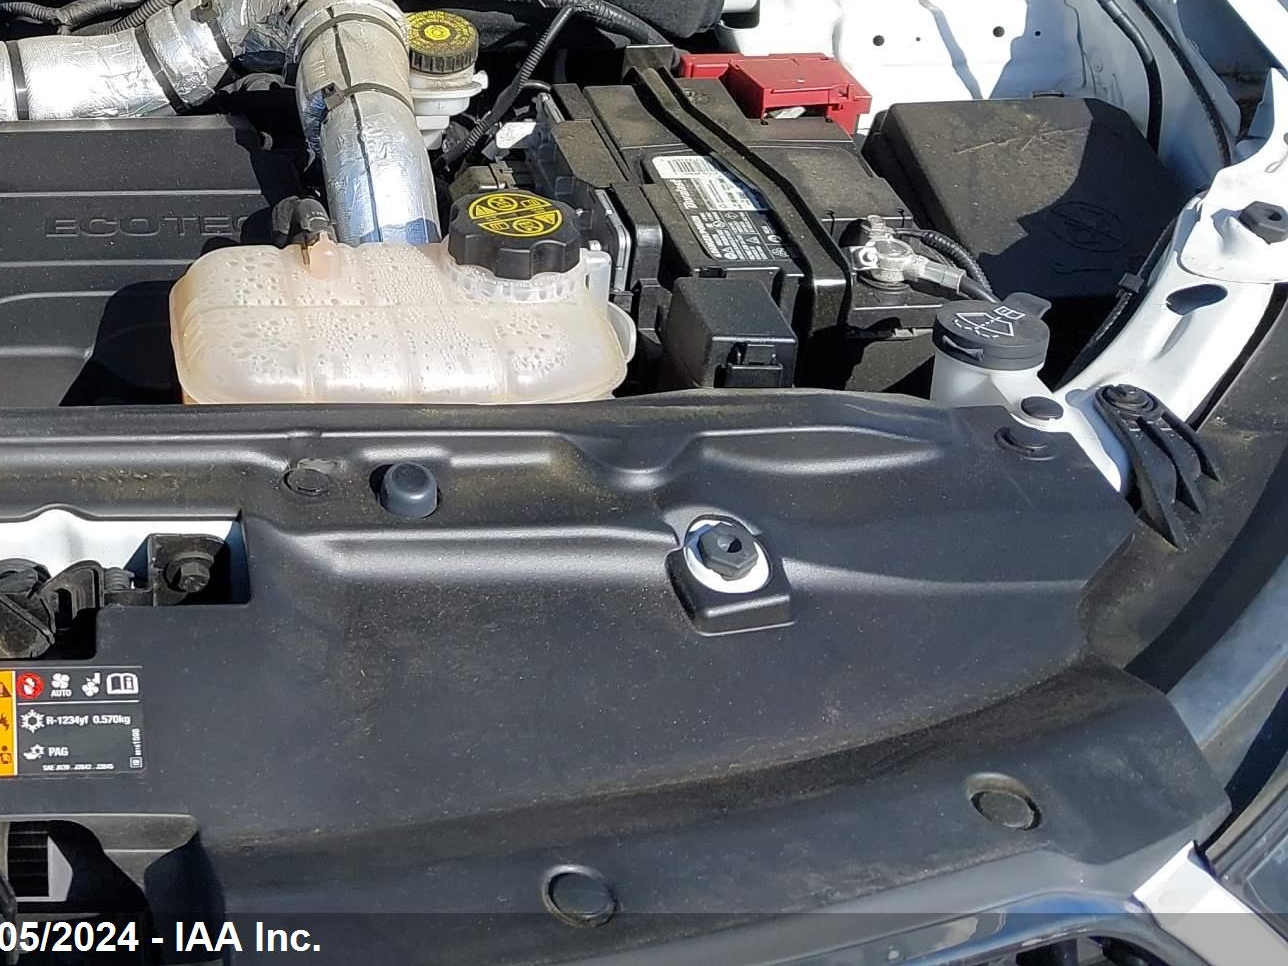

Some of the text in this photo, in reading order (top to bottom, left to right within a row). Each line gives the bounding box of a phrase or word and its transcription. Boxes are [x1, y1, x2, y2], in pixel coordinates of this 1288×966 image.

[50, 689, 72, 698] AUTO
[45, 714, 131, 726] R-1234yf 0.570kg
[48, 746, 69, 757] PAG
